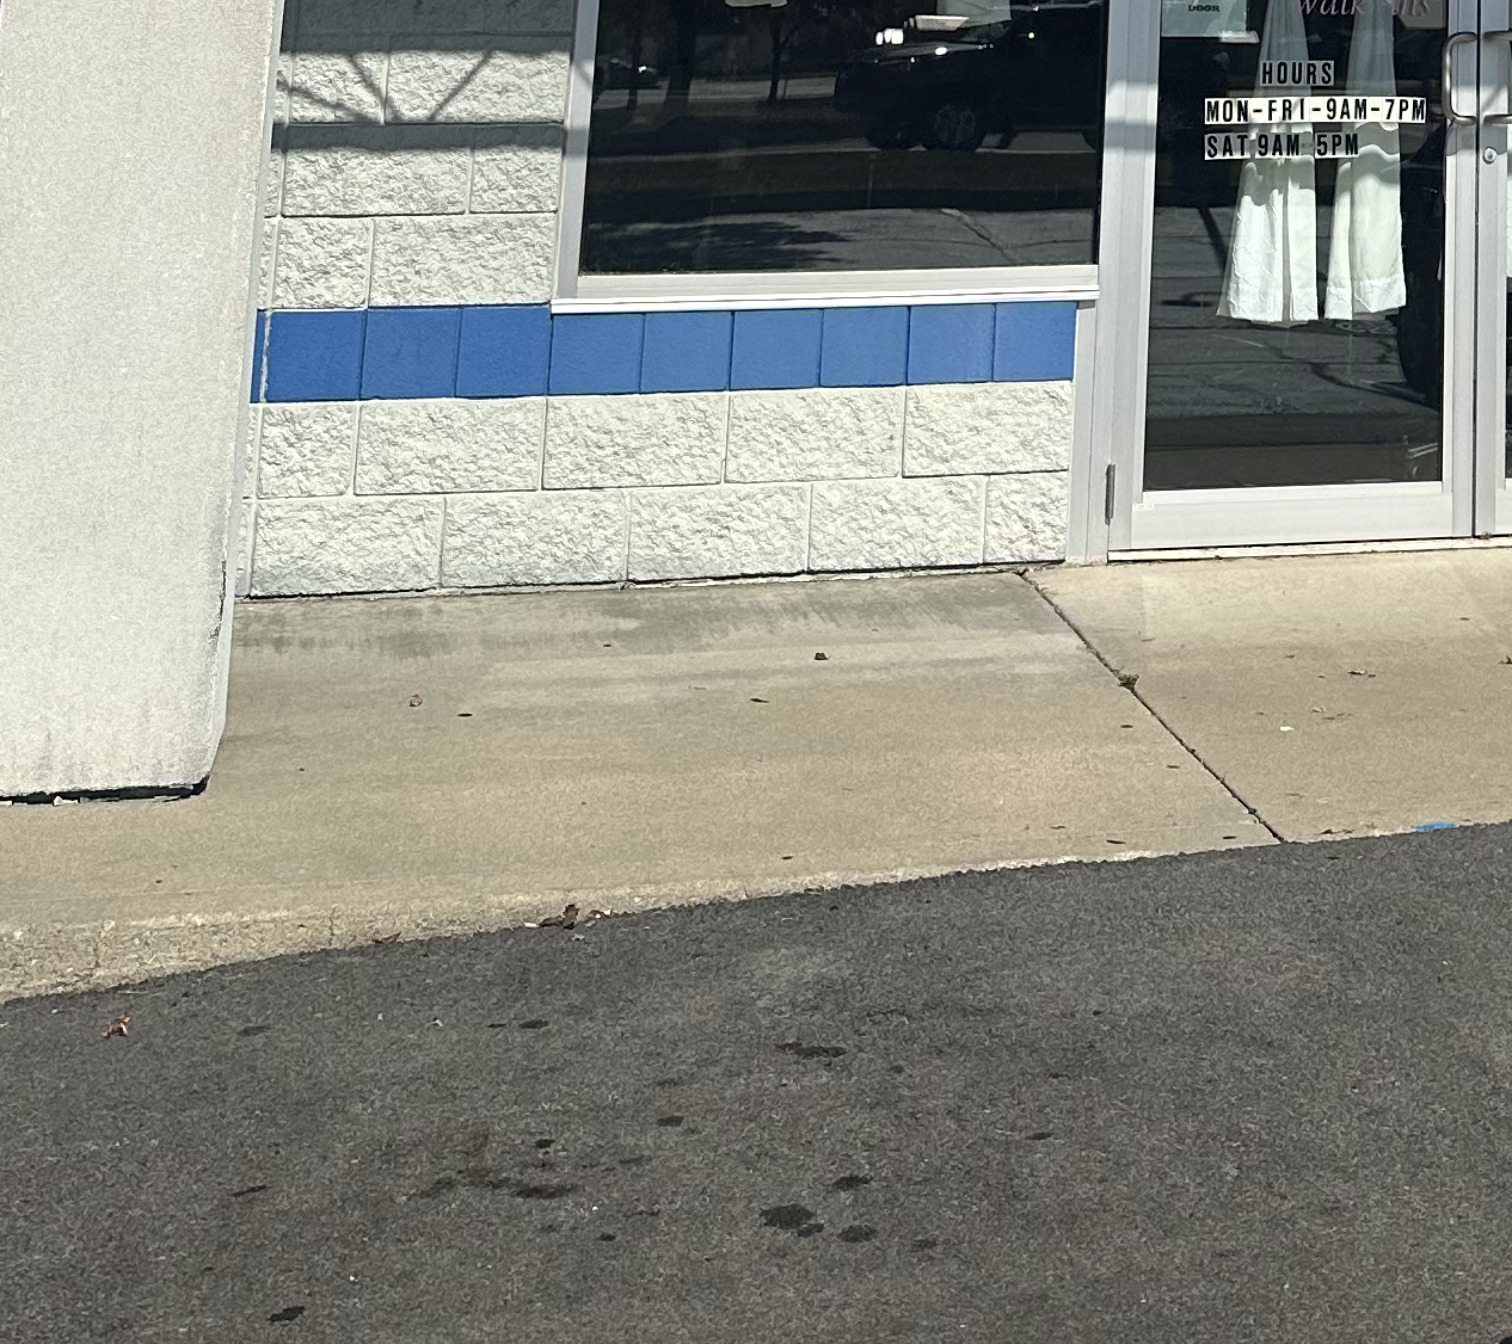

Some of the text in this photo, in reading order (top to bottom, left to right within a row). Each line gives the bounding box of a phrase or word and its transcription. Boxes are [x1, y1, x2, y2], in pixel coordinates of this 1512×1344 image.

[1187, 4, 1220, 13] DOOR
[1261, 62, 1332, 85] HOURS
[1207, 133, 1360, 158] SAT 9AM 5PM
